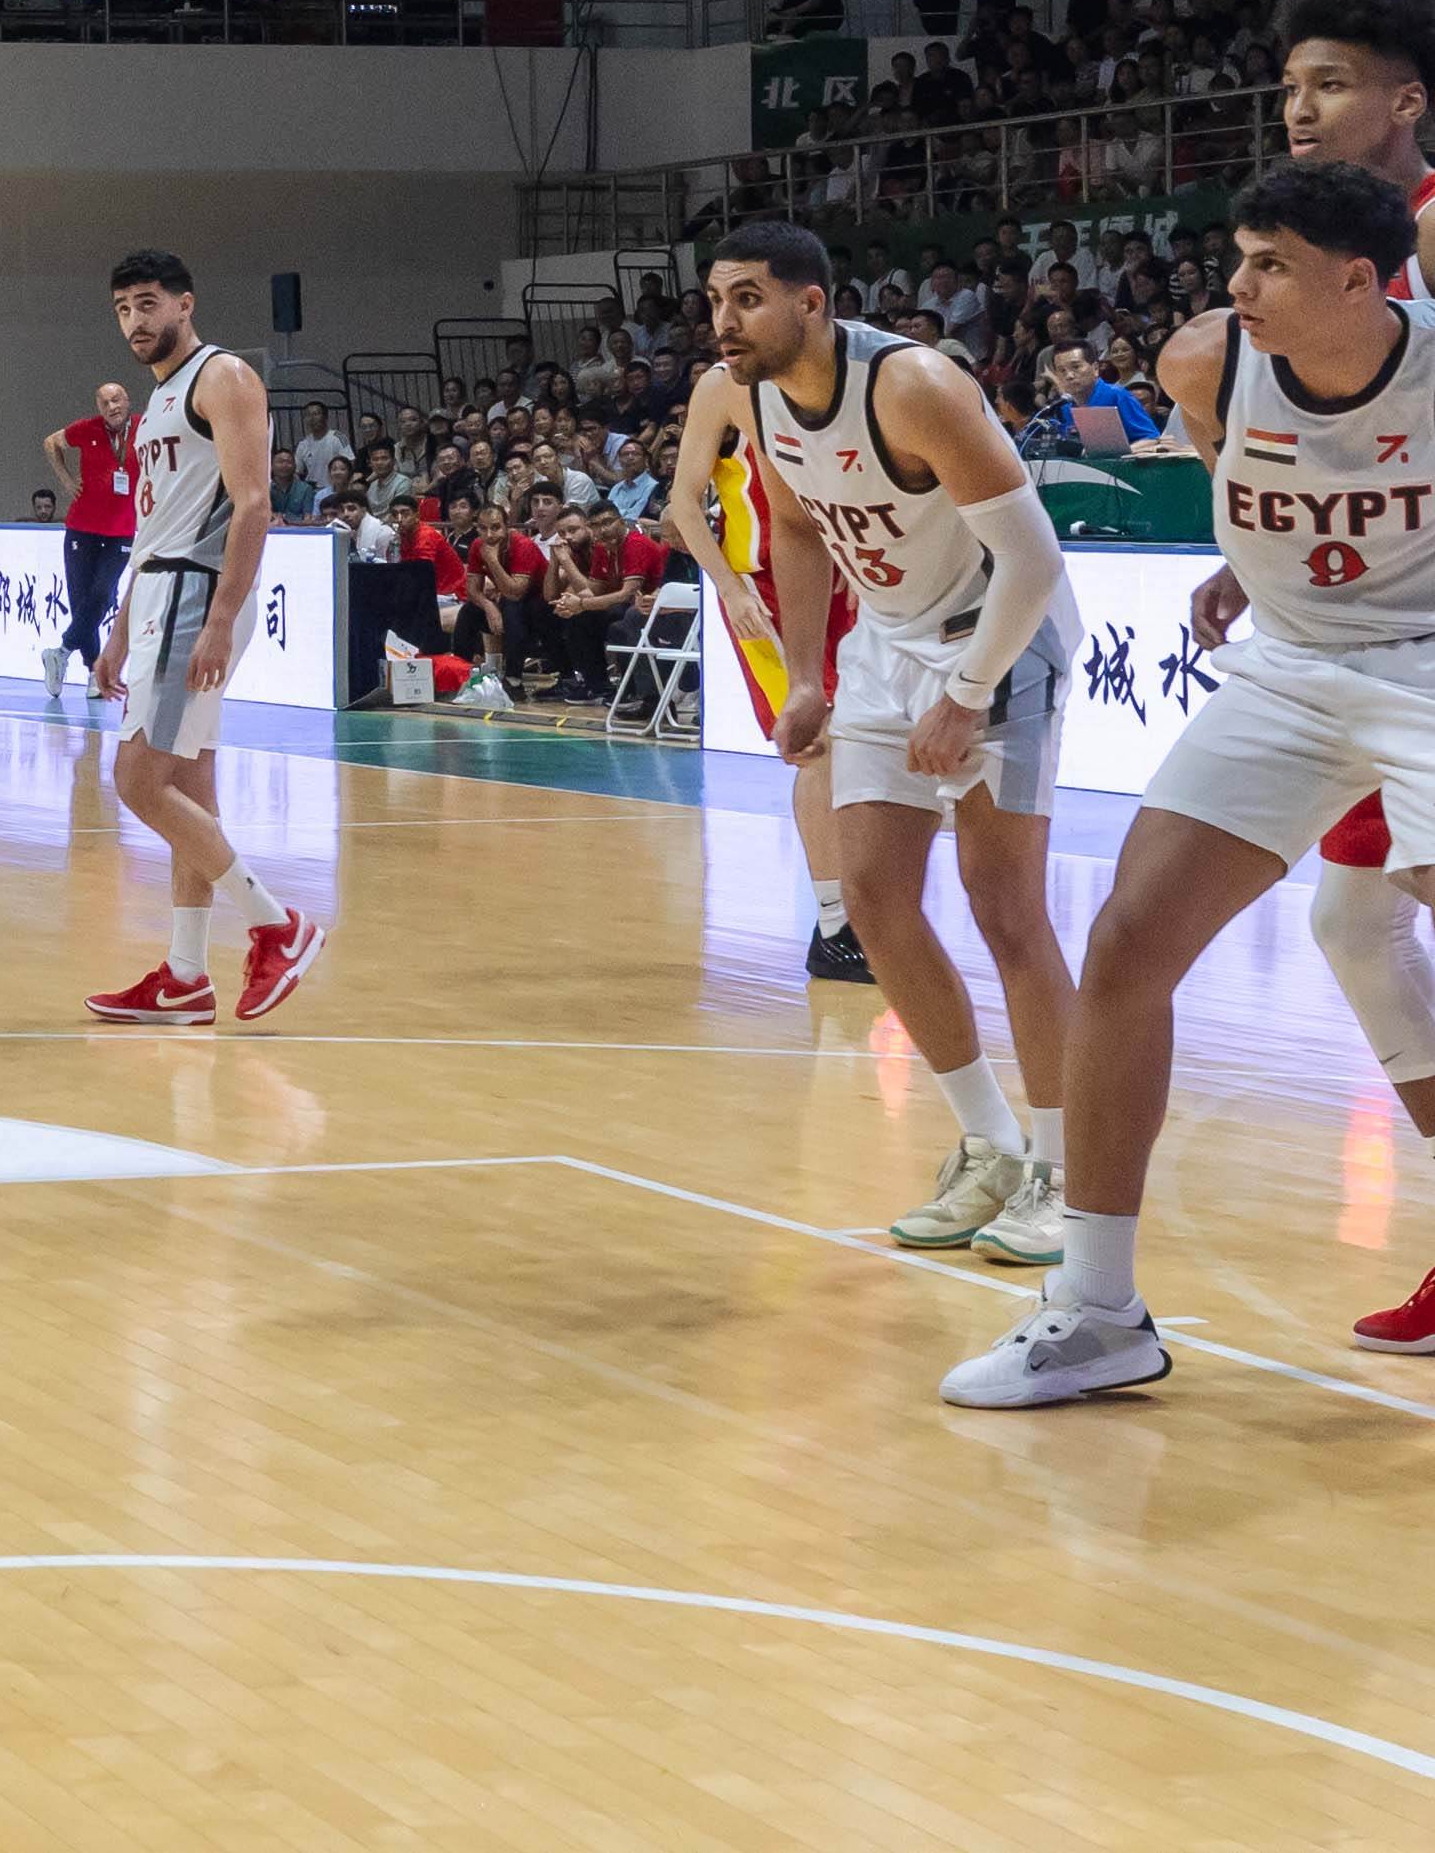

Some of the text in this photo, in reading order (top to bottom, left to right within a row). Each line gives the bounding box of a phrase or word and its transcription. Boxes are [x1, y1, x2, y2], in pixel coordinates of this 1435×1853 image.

[760, 76, 860, 109] 北区
[799, 494, 906, 544] GYPT
[1227, 479, 1432, 537] EGYPT
[1301, 541, 1370, 587] 9
